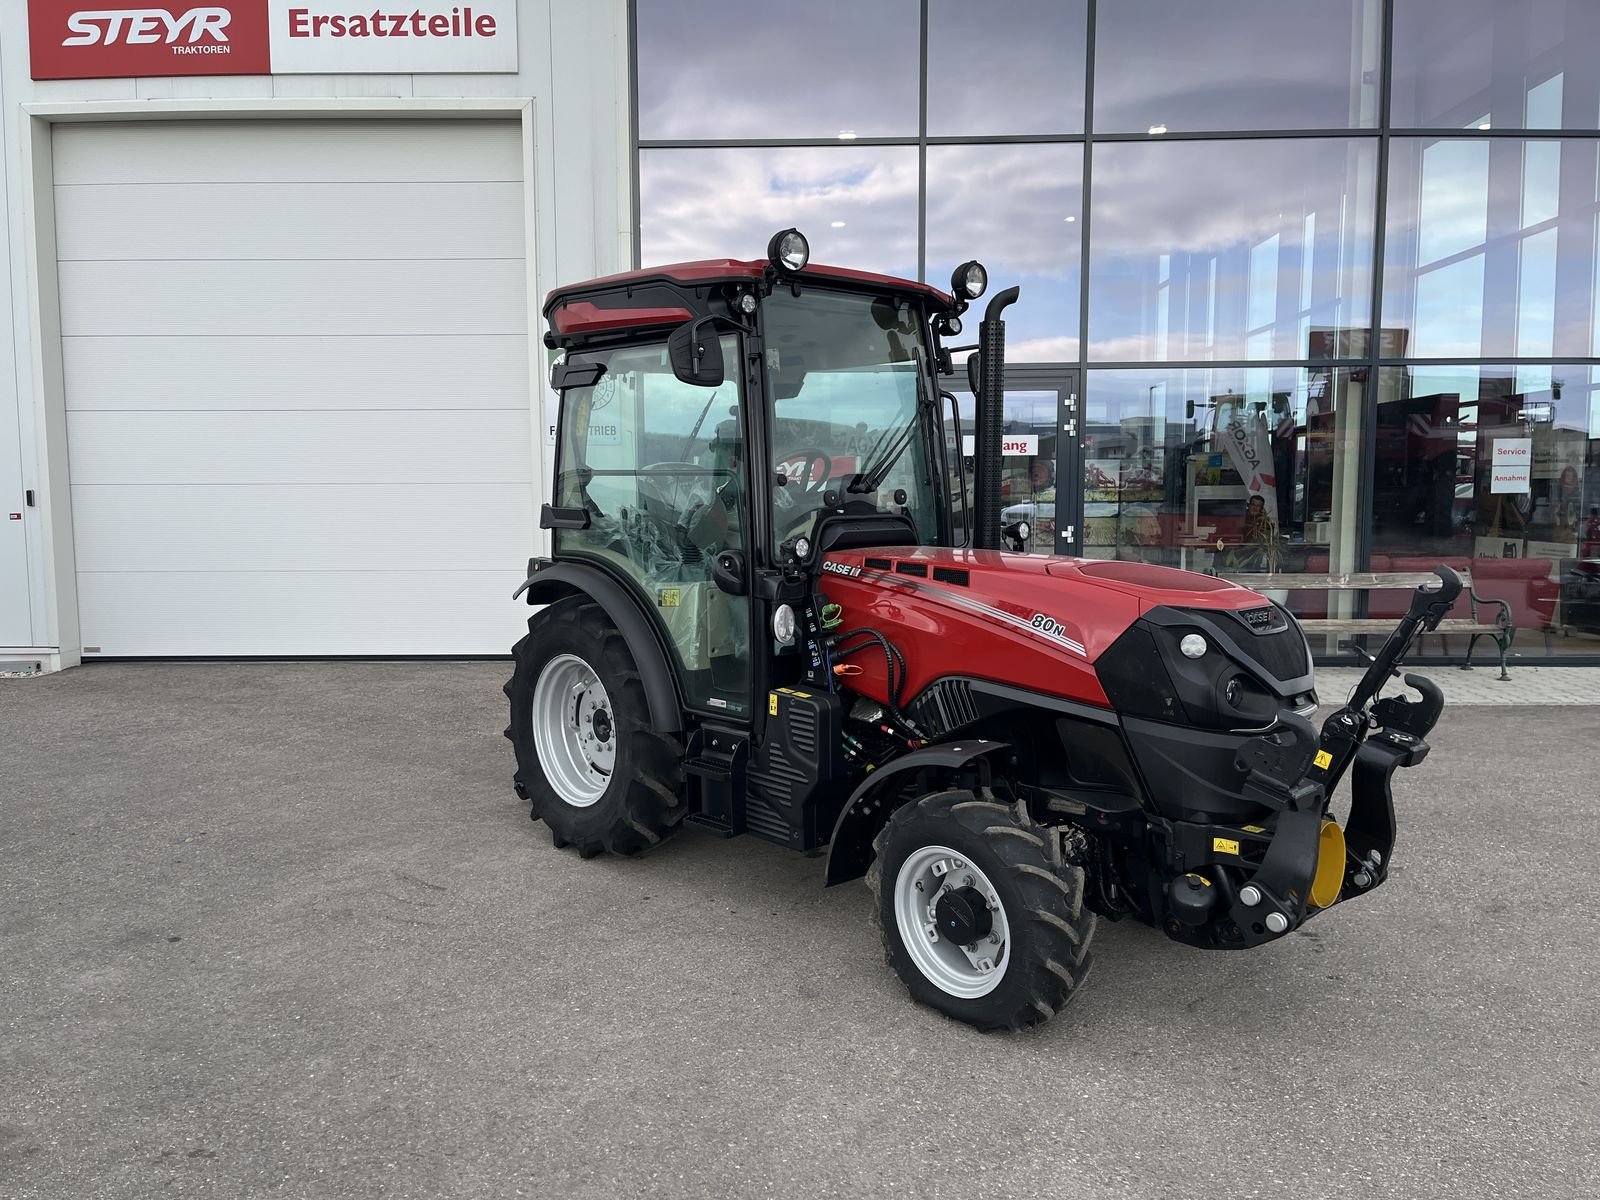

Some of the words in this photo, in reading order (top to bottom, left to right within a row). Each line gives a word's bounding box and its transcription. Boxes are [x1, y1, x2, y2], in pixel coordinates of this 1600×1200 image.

[61, 7, 232, 47] STEYR
[287, 7, 497, 38] Ersatzteile
[171, 44, 231, 55] TRAKTOREN
[1497, 447, 1527, 456] Service
[1494, 474, 1527, 482] Annahme
[822, 560, 851, 575] CASE
[1031, 614, 1065, 636] 80N
